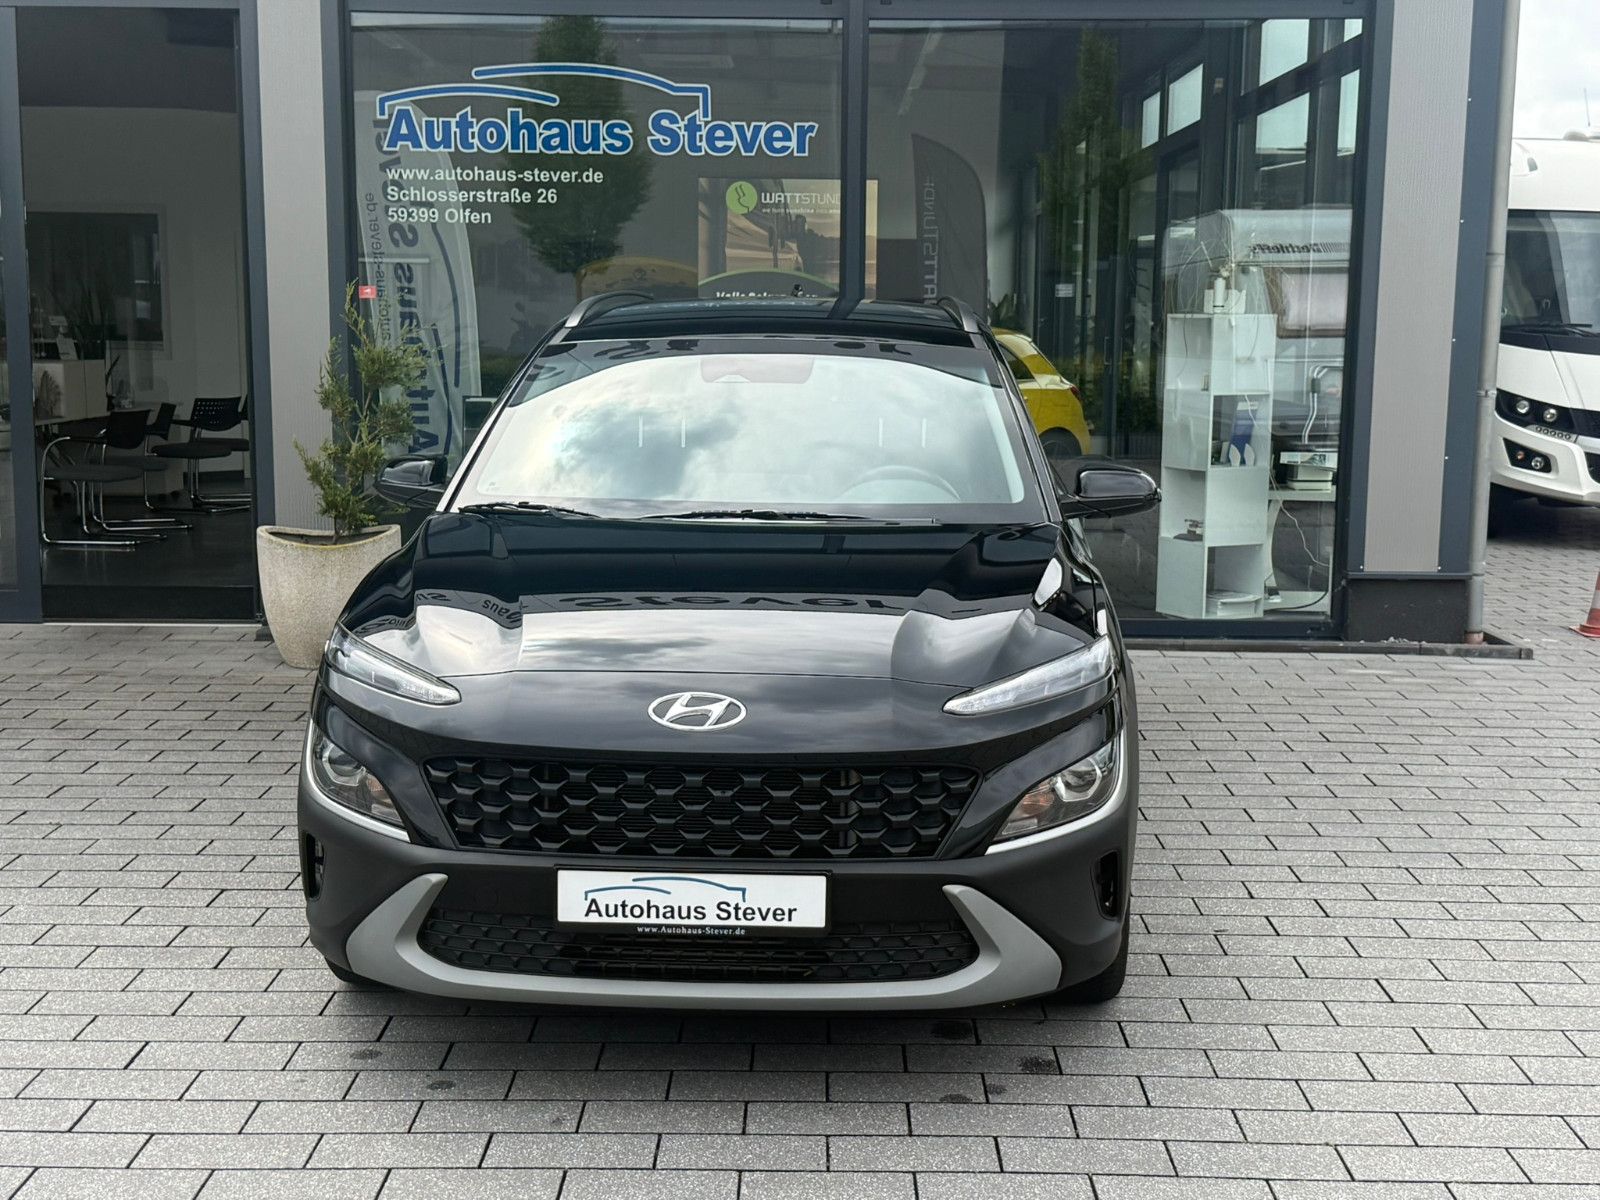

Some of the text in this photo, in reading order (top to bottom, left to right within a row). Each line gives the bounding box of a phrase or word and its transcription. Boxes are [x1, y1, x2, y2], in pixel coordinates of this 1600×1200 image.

[383, 106, 818, 157] Autohaus Stever
[386, 167, 604, 184] www.autohaus-stever.de
[387, 186, 558, 205] Schlosserstraße 26
[761, 192, 841, 204] WATTSTUN
[387, 207, 492, 224] 59399 Olfen
[584, 898, 797, 922] Autohaus Stever
[636, 925, 746, 936] www.Autohaus-Stever.de
